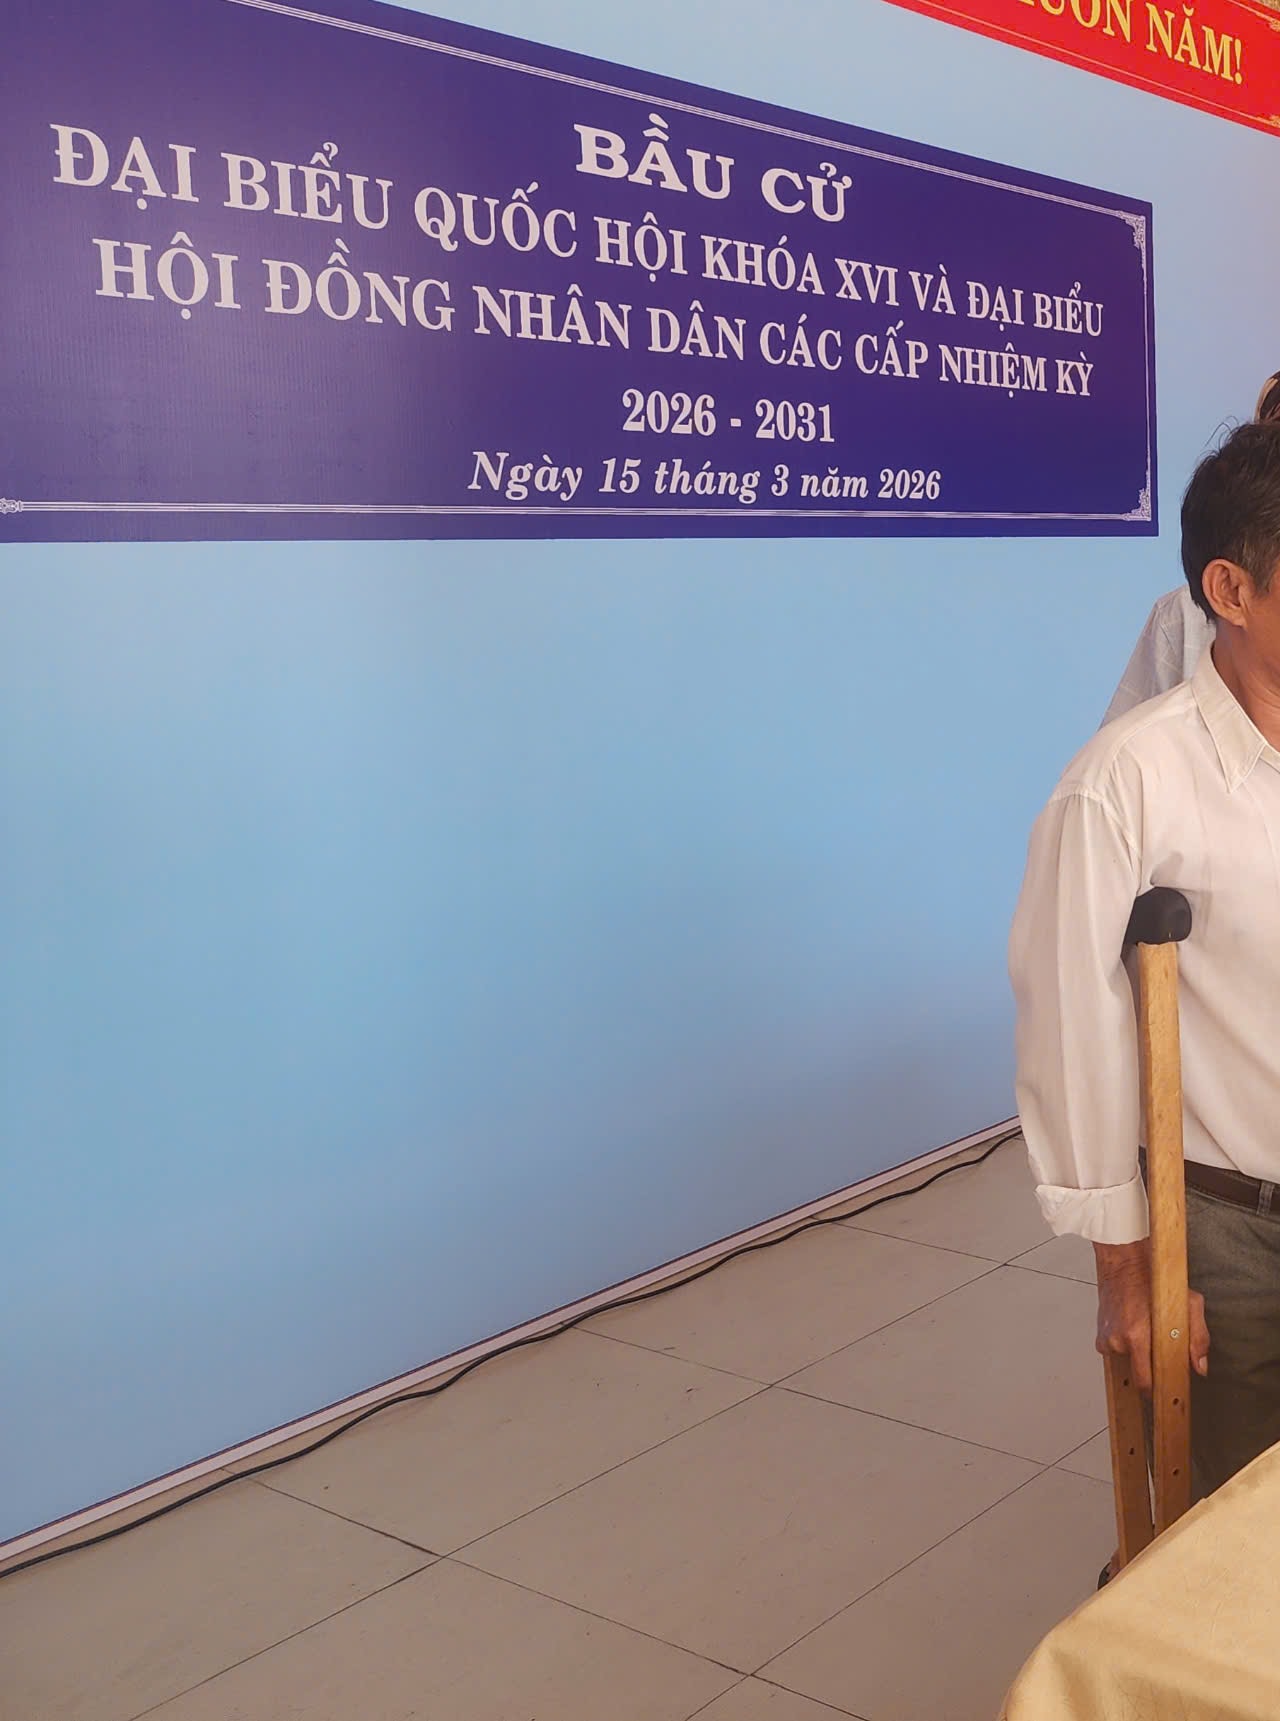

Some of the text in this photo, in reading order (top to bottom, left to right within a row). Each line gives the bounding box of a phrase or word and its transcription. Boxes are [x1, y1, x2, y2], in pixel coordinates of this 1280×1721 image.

[1146, 3, 1242, 84] NĂM!
[574, 112, 852, 221] BẦU CỬ
[50, 124, 1103, 336] ĐẠI BIỂU QUỐC HỘI KHÓA XVI VÀ ĐẠI BIỂU
[92, 232, 1093, 397] HỘI ĐỒNG NHÂN DÂN CÁC CẤP NHIỆM KỲ
[623, 389, 834, 442] 2026 - 2031
[468, 452, 940, 503] Ngày 15 tháng 3 năm 2026
